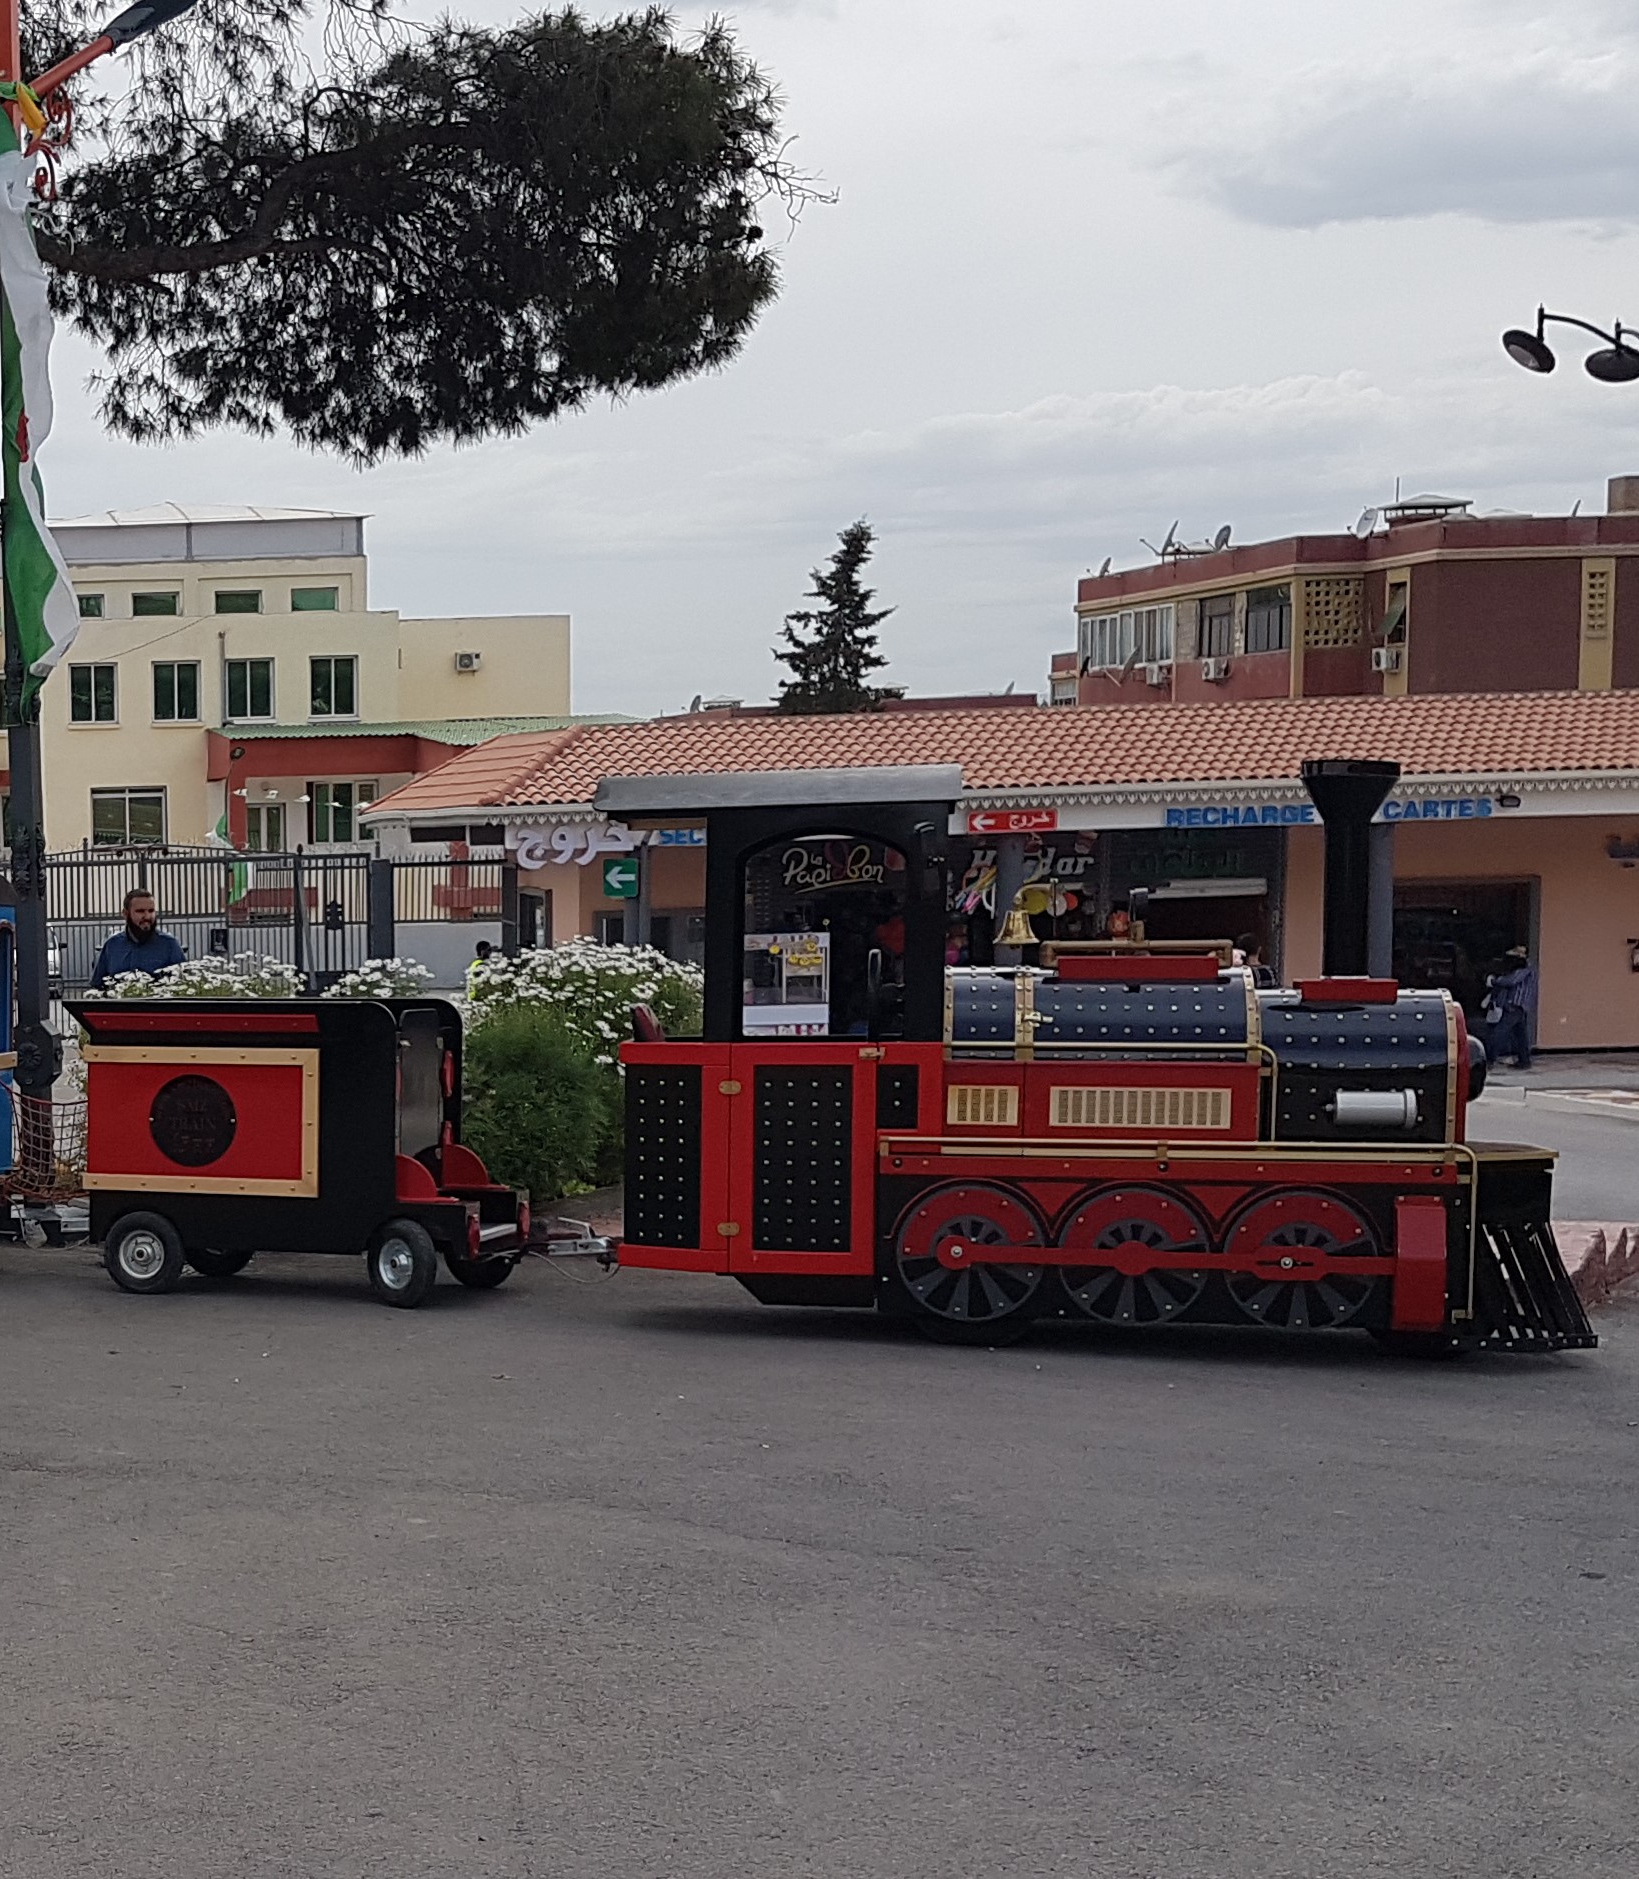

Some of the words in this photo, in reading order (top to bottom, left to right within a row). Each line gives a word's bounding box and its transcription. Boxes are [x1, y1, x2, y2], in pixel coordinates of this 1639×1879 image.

[1009, 810, 1050, 830] خروج
[1165, 804, 1315, 826] RECHARGE
[1383, 798, 1493, 819] CARTES
[516, 820, 636, 870] خروج
